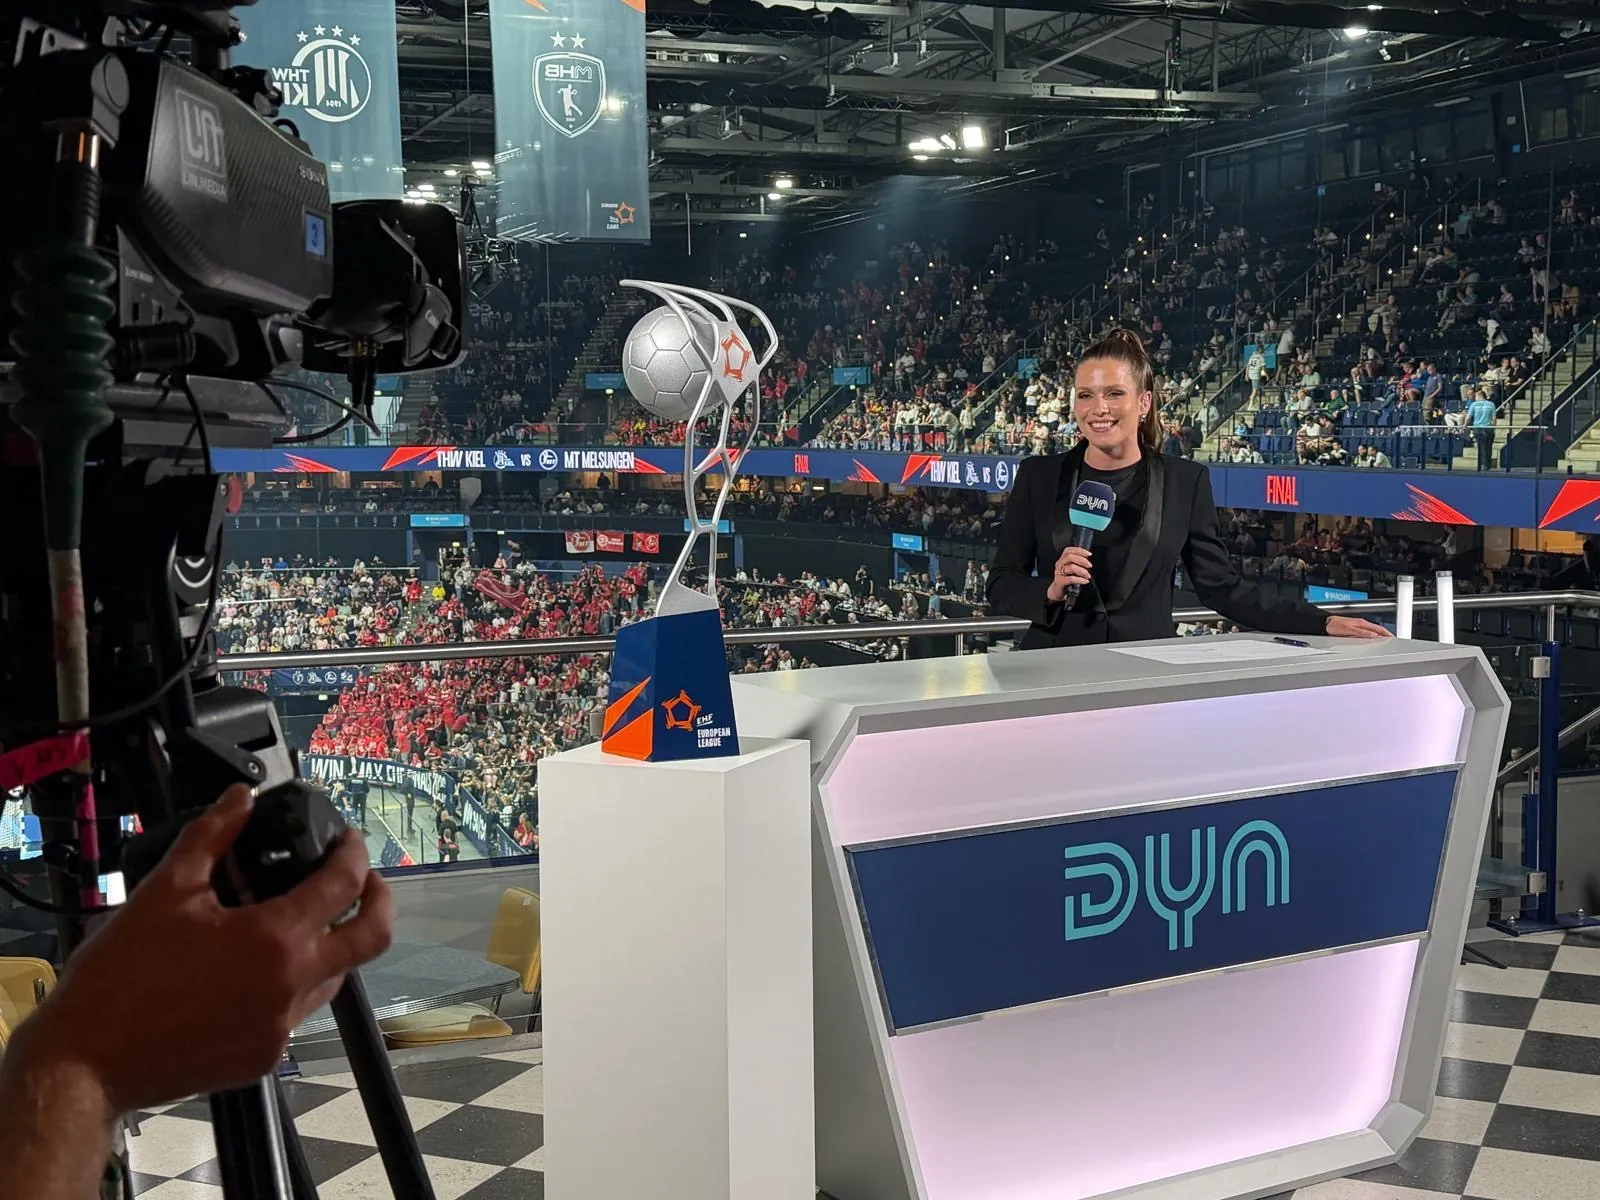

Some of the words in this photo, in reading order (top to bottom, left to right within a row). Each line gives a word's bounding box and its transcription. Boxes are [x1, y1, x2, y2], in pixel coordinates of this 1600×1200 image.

[299, 164, 325, 186] SONY
[436, 451, 461, 468] THW
[465, 451, 486, 468] KIEL
[520, 454, 532, 466] VS
[564, 451, 580, 469] MT
[581, 451, 635, 469] MELSUNGEN
[794, 454, 810, 473] FINAL
[930, 461, 946, 483] THW
[946, 461, 961, 484] KIEL
[1266, 475, 1299, 506] FINAL
[1076, 493, 1109, 511] DYN
[696, 713, 714, 726] EHF
[697, 727, 731, 739] EUROPEAN
[697, 738, 722, 748] LEAGUE
[1064, 819, 1291, 951] DYN
